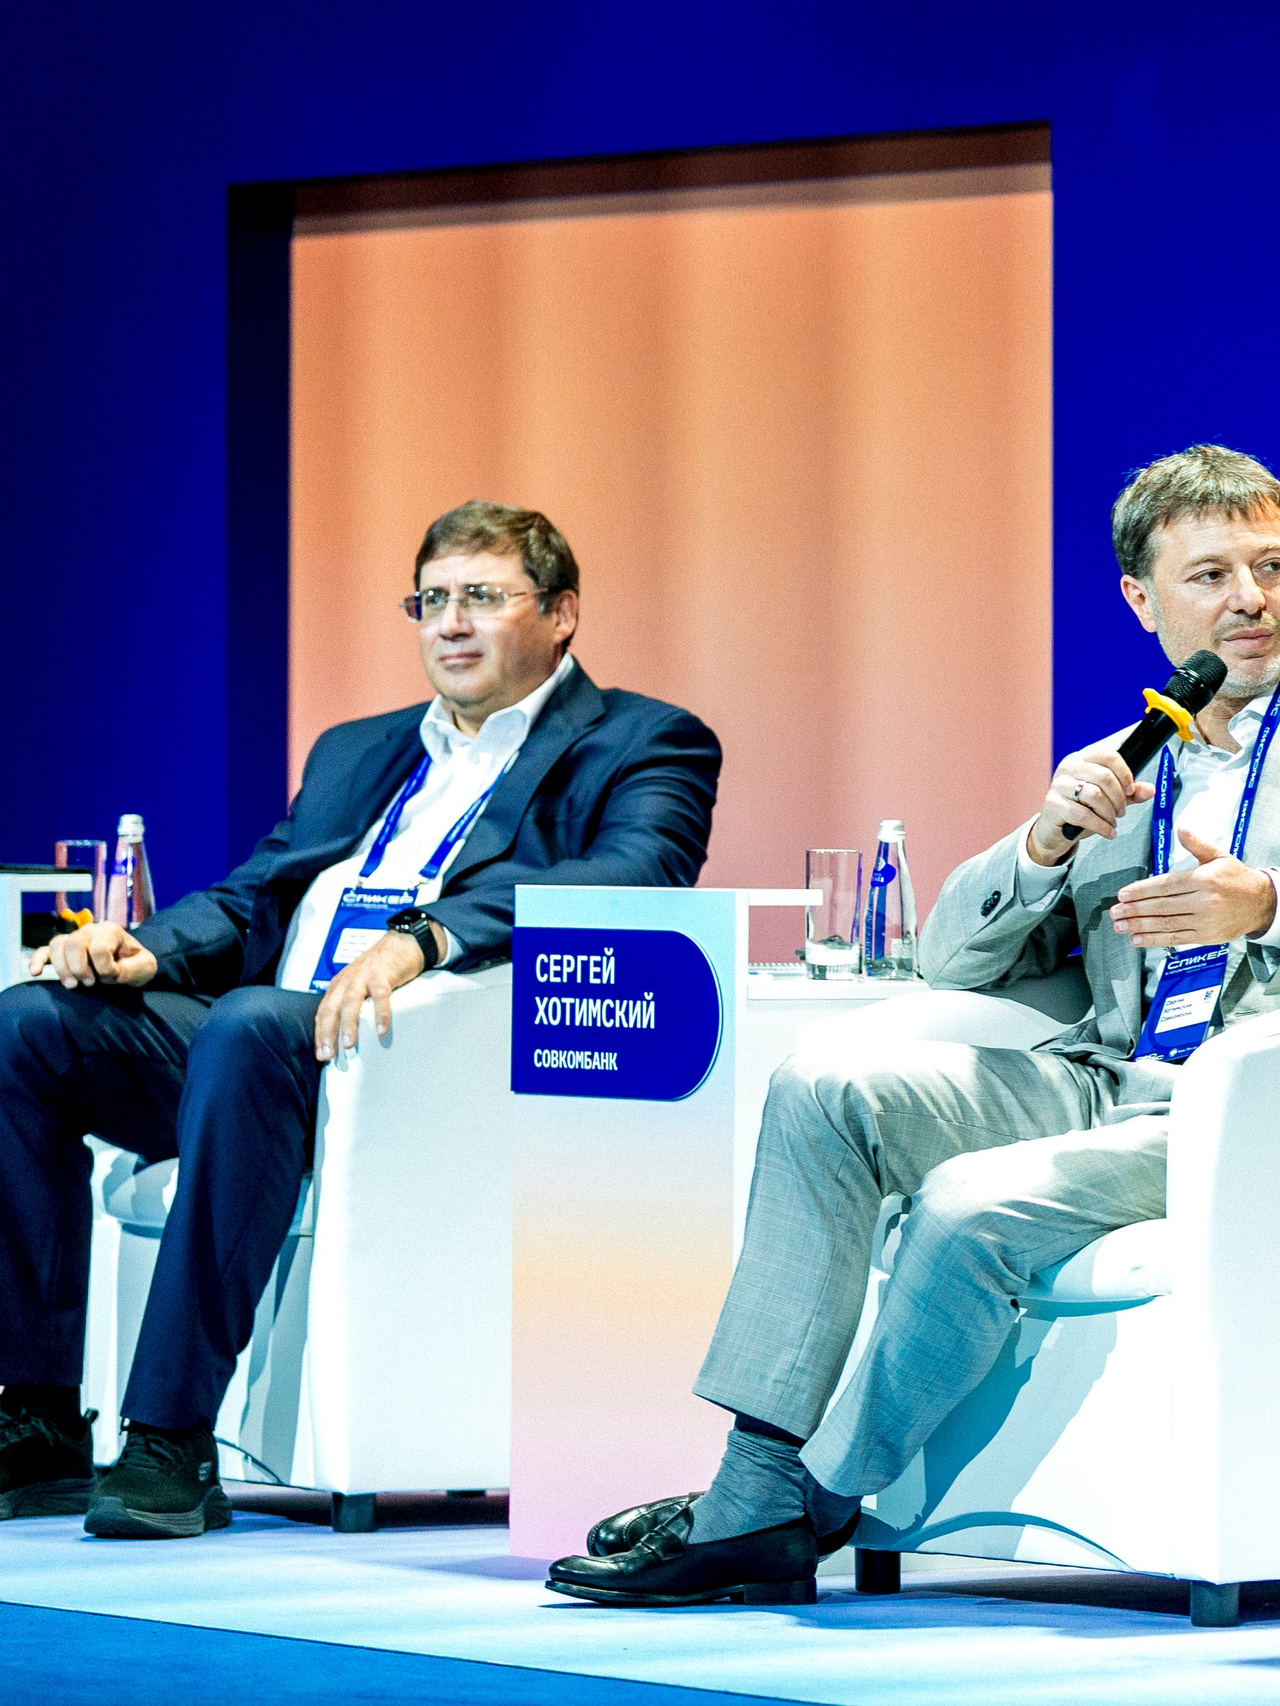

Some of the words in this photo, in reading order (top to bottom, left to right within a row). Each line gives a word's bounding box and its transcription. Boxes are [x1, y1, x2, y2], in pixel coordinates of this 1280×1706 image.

[1157, 818, 1166, 874] ИНОПОЛИС
[535, 947, 615, 984] СЕРГЕЙ
[1167, 948, 1229, 970] СПИКЕР
[534, 991, 655, 1029] ХОТИМСКИЙ
[533, 1048, 618, 1071] СОВКОМБАНК
